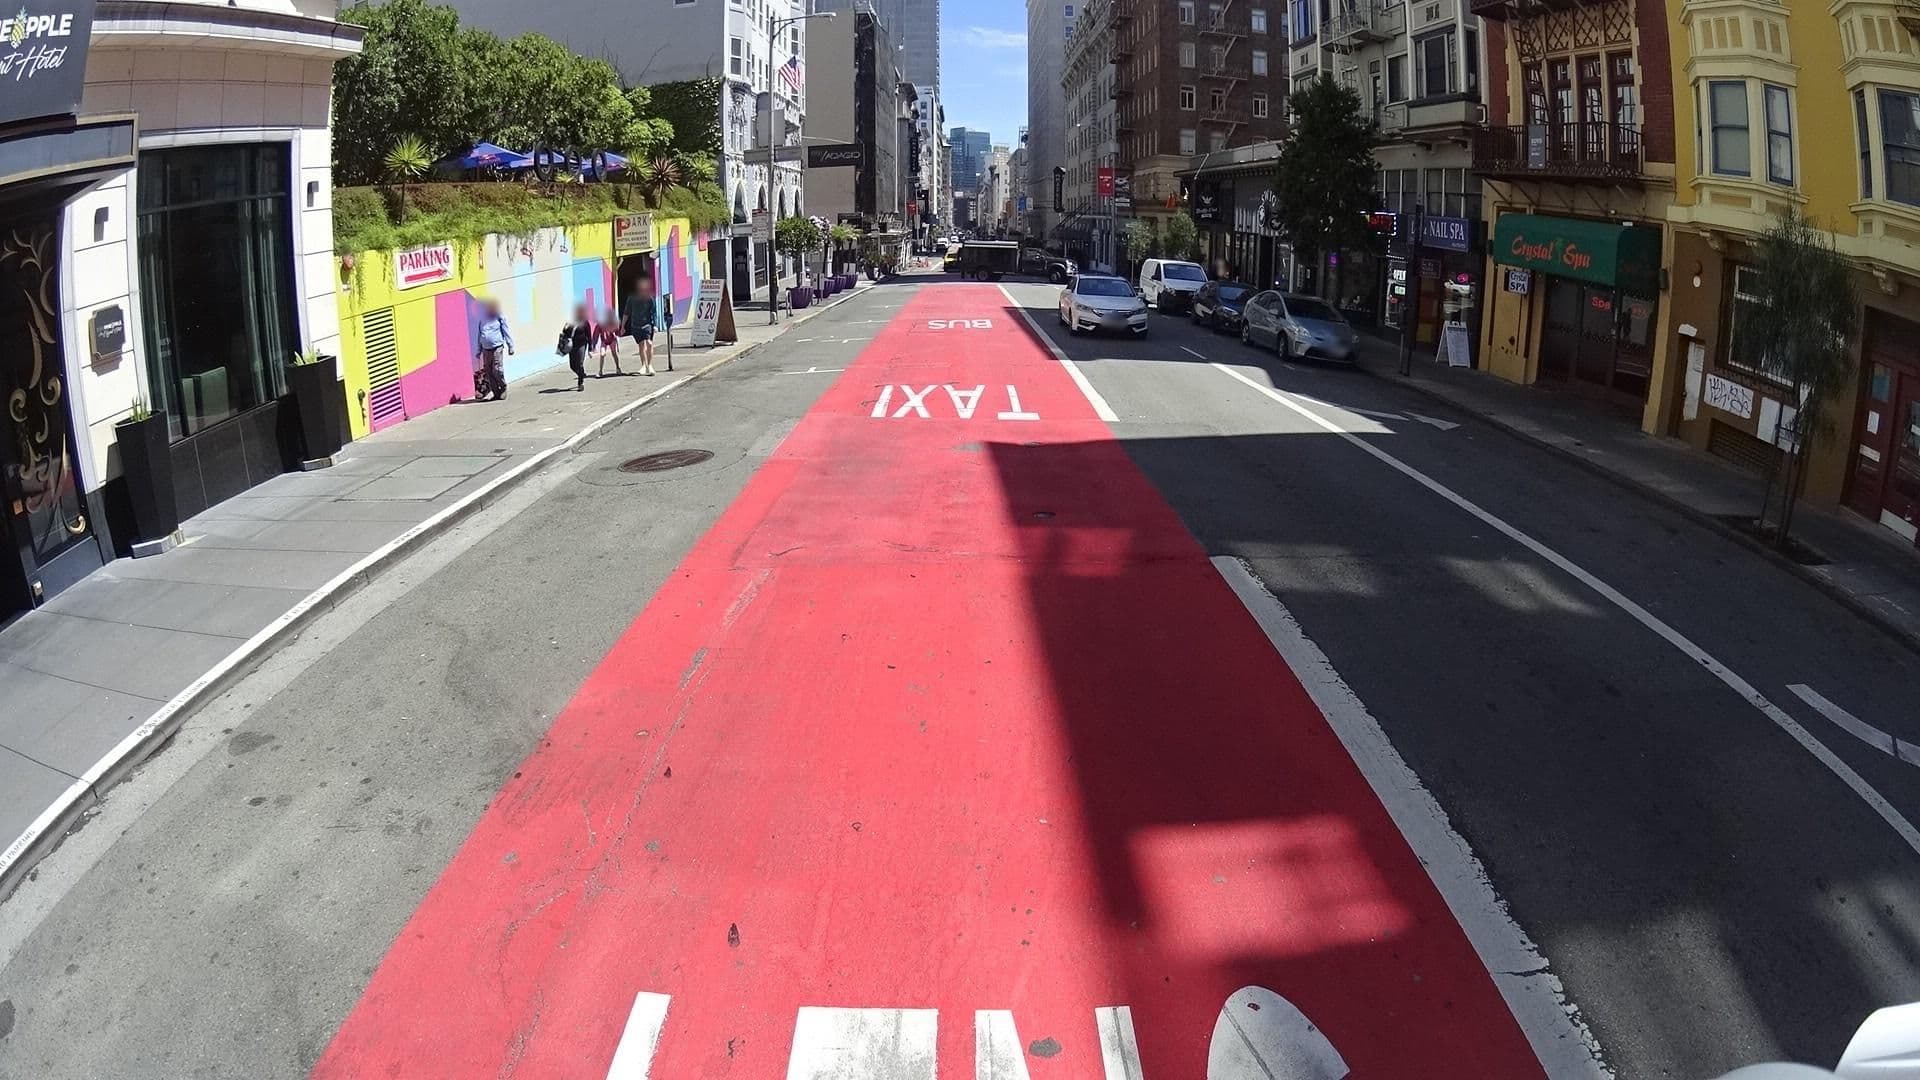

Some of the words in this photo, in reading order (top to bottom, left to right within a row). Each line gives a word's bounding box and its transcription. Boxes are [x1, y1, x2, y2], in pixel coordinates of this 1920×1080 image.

[16, 44, 68, 81] Hotel
[616, 216, 648, 238] PARK
[1429, 220, 1448, 239] NAIL
[1450, 222, 1465, 241] SPA
[400, 247, 450, 271] PARKING
[1512, 234, 1554, 261] Crystal
[1562, 243, 1592, 271] Spa
[1510, 281, 1526, 292] SPA
[704, 302, 716, 320] 20
[928, 319, 993, 330] BUS
[870, 384, 1040, 421] TAXI
